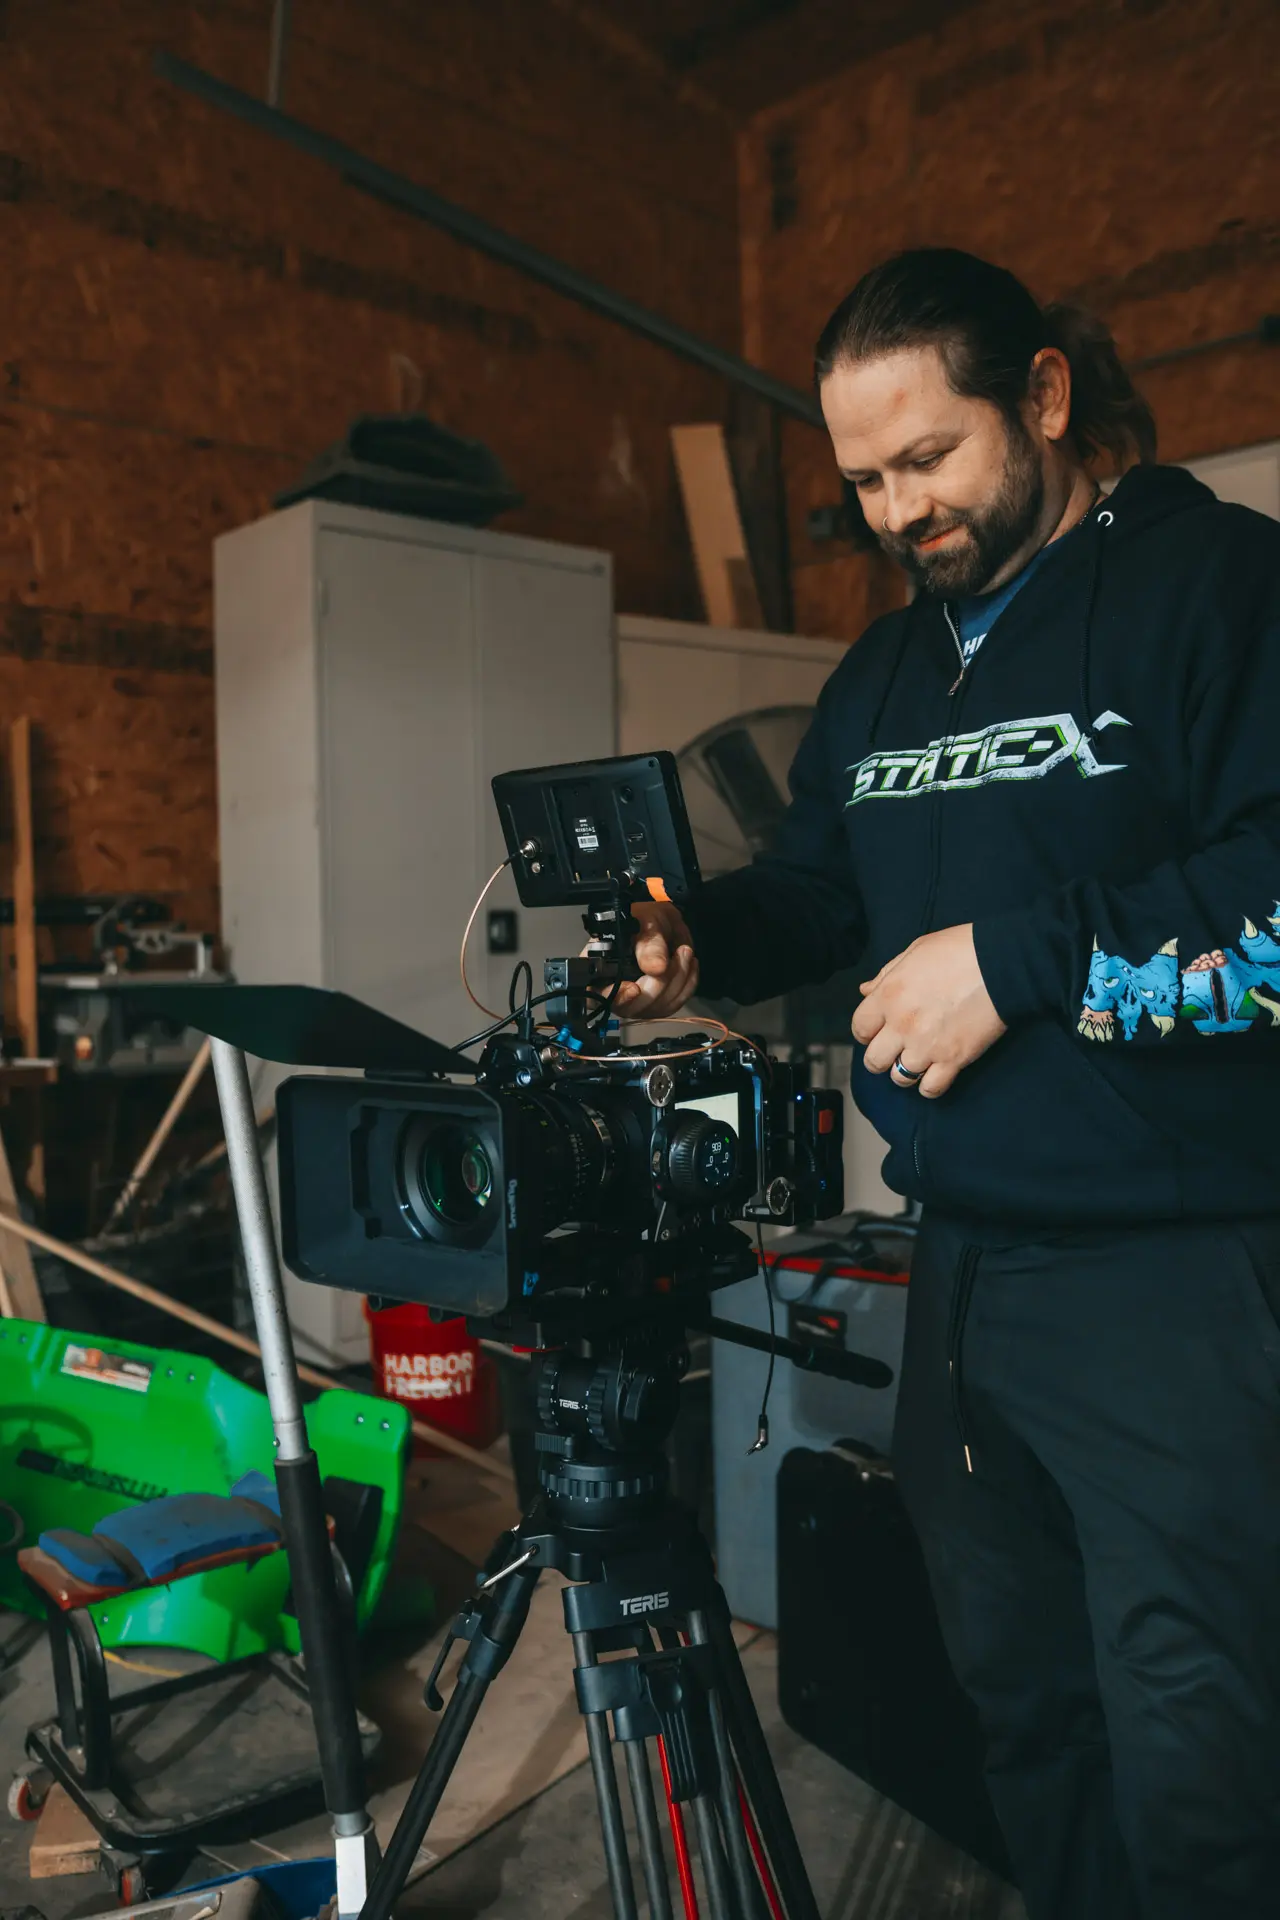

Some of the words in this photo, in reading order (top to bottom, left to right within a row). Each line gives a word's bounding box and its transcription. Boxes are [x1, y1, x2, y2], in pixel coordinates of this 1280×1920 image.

[843, 710, 1133, 812] STATIC-X
[384, 1352, 473, 1376] HARBOR
[619, 1591, 670, 1616] TERIS
